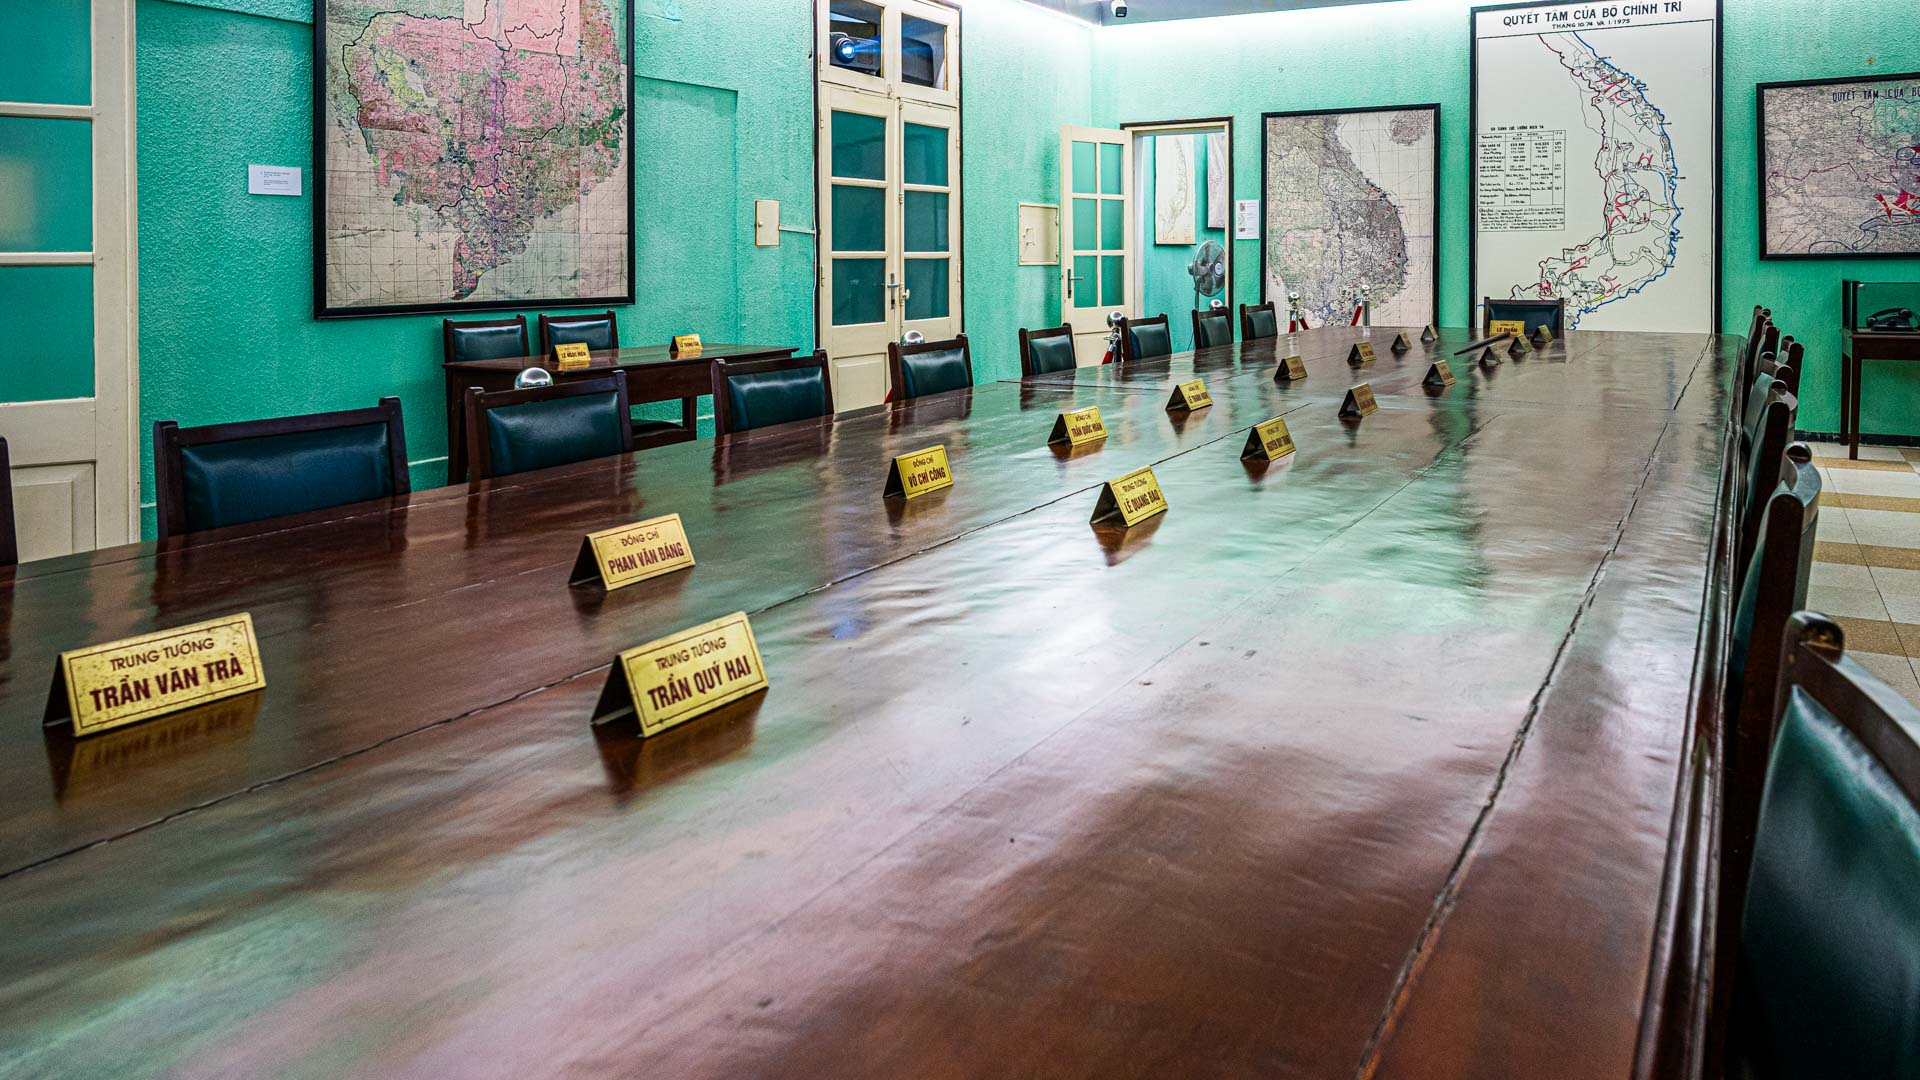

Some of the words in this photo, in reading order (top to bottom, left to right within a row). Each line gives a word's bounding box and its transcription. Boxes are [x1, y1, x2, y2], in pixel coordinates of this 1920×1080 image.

[917, 469, 930, 485] CHÍ
[1124, 498, 1133, 514] LÊ
[1131, 493, 1151, 512] QUANG
[647, 527, 660, 541] CHÍ
[608, 554, 638, 575] PHAN
[636, 546, 659, 566] VĂN
[110, 650, 160, 672] TRUNG
[655, 650, 690, 671] TRUNG
[89, 674, 151, 712] TRẦN
[154, 667, 200, 695] VĂN
[203, 652, 244, 683] TRÀ
[647, 673, 693, 711] TRẦN
[693, 660, 723, 695] QUÝ
[724, 655, 752, 682] HAI
